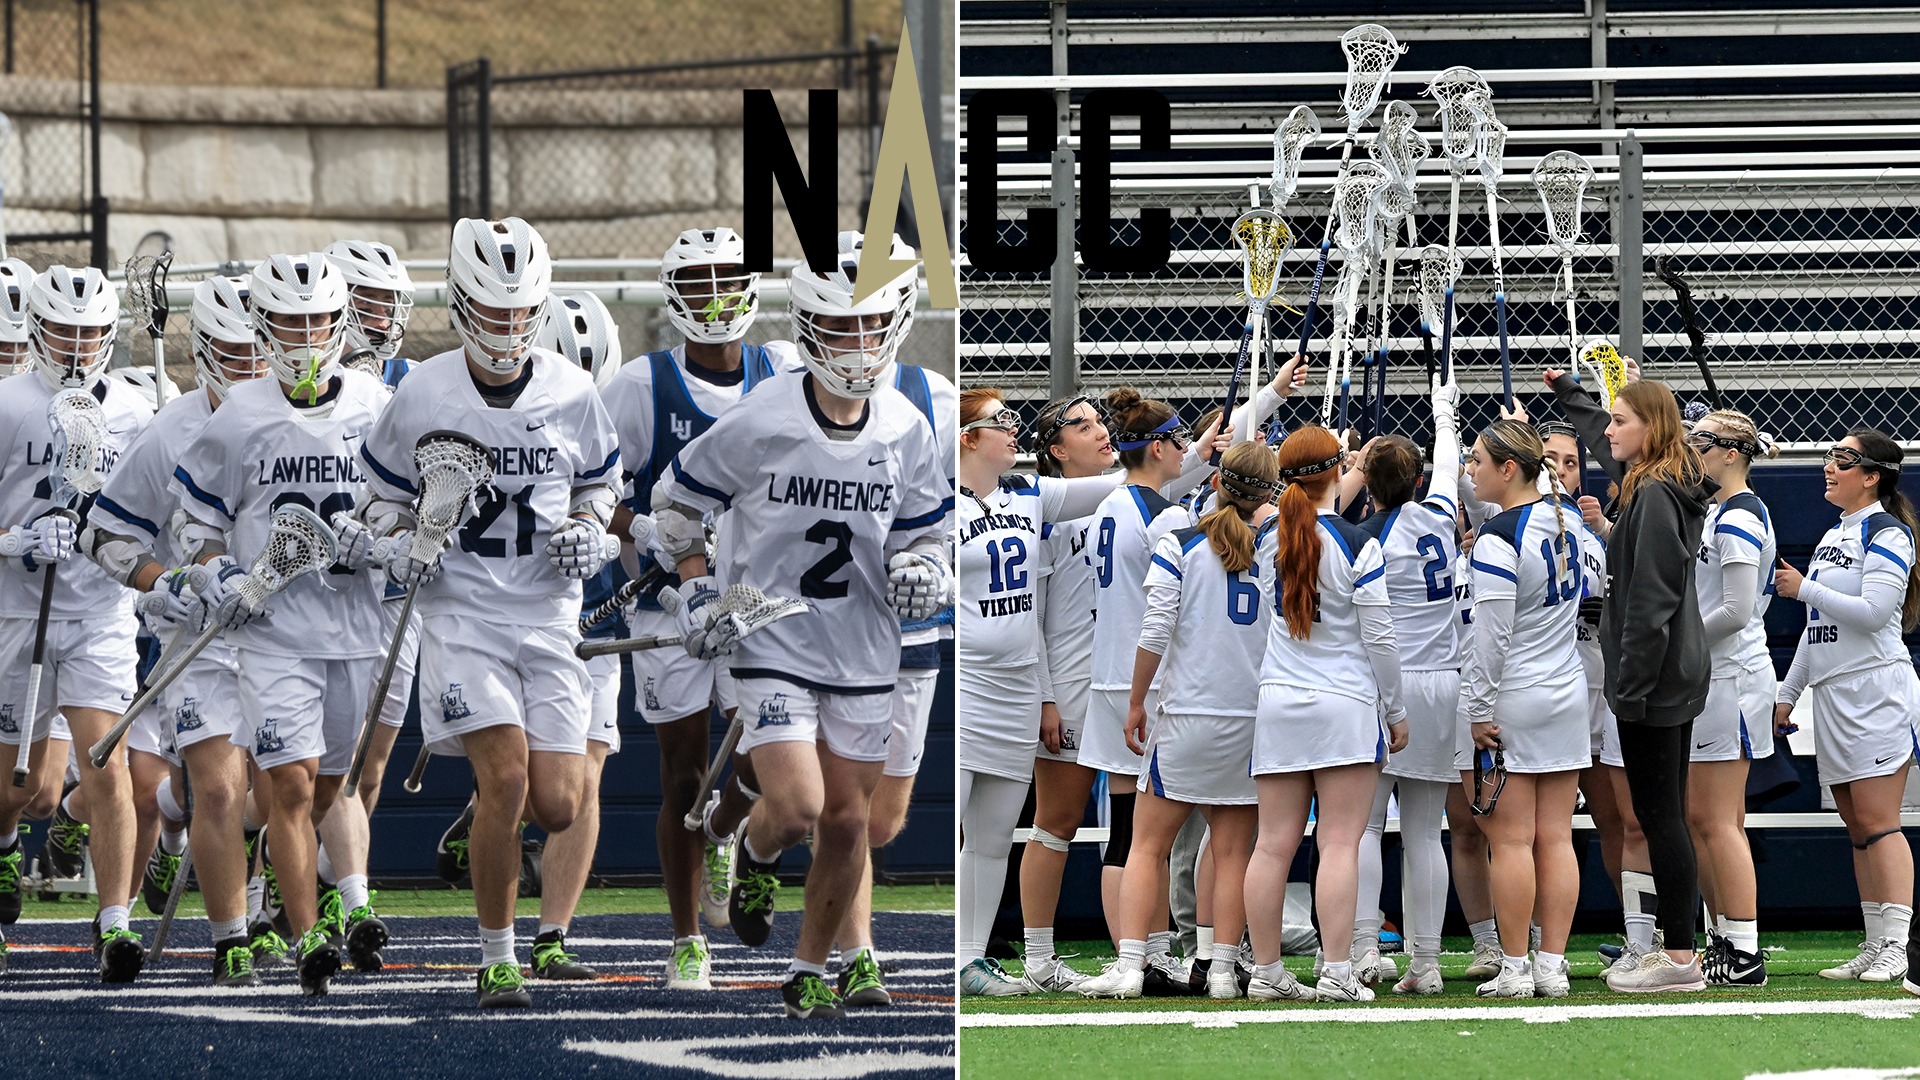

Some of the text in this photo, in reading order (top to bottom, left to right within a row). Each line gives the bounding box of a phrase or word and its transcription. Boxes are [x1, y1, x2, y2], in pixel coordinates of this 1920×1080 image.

[459, 483, 536, 558] 21
[768, 473, 894, 512] LAWRENCE
[800, 519, 853, 600] 2
[960, 514, 1036, 546] LAWRENCE
[1096, 517, 1116, 588] 9
[986, 536, 1027, 593] 12
[1227, 561, 1260, 626] 6
[1416, 533, 1452, 602] 2
[1541, 530, 1581, 607] 13
[978, 593, 1032, 618] VIKINGS
